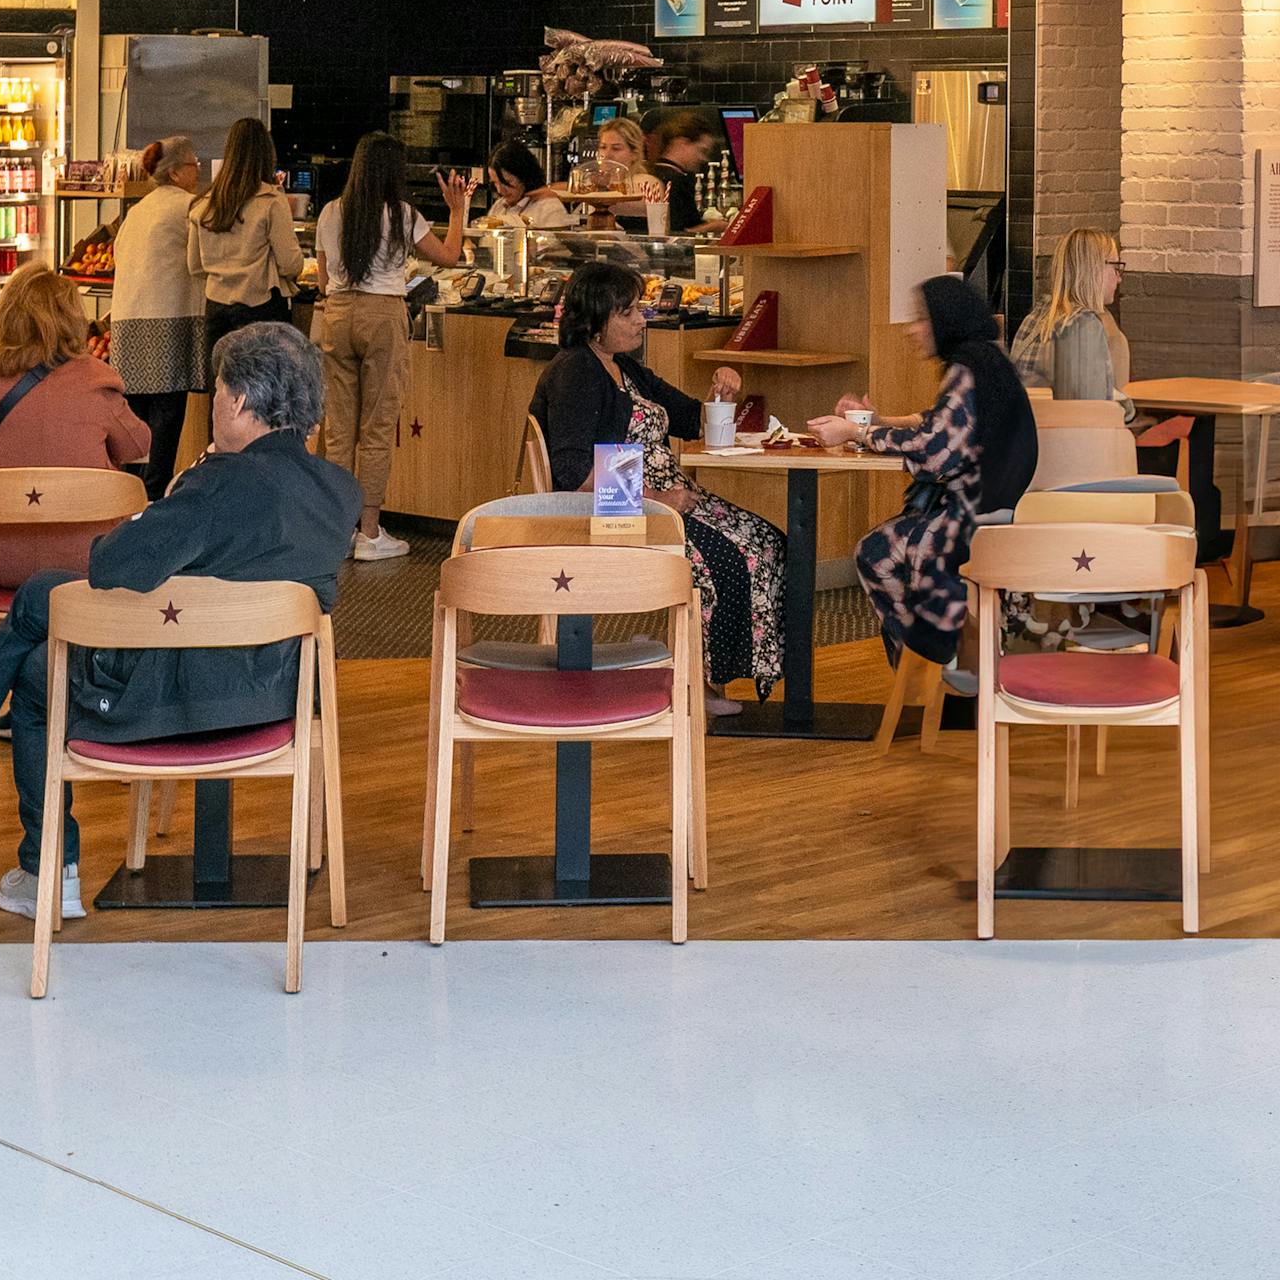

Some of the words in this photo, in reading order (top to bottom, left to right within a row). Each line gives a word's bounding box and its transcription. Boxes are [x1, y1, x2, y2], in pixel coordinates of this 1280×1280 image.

[731, 215, 747, 234] JUST
[744, 198, 758, 213] EAT
[734, 321, 753, 342] UBER
[750, 299, 767, 319] EATS
[598, 486, 618, 494] Order
[599, 494, 614, 502] your
